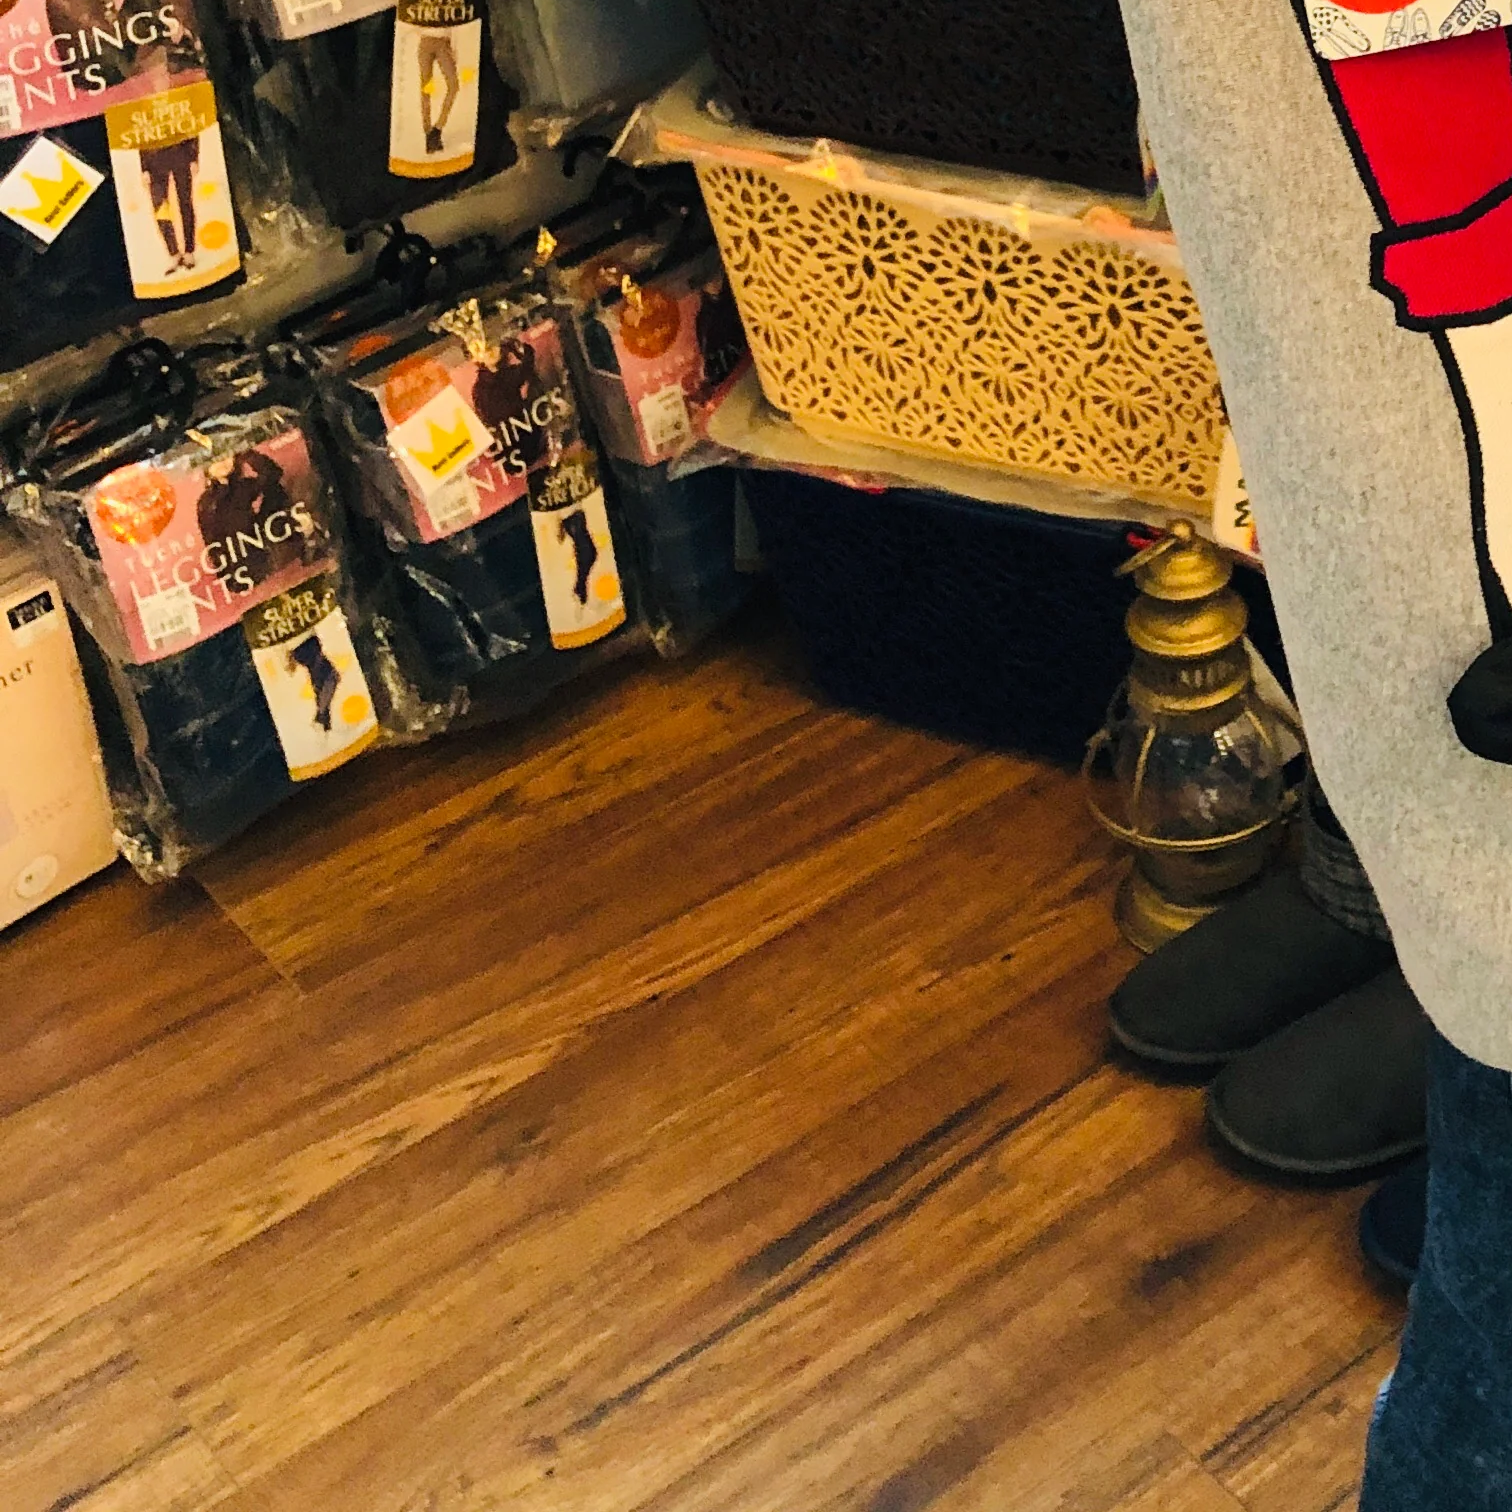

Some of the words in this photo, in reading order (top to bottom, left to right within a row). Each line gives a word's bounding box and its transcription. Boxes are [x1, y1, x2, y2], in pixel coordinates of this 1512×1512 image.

[8, 4, 181, 76] GGINGS
[24, 62, 107, 110] NTS
[120, 112, 207, 150] STRETCH
[131, 99, 193, 128] SUPER
[190, 565, 255, 614] NTS
